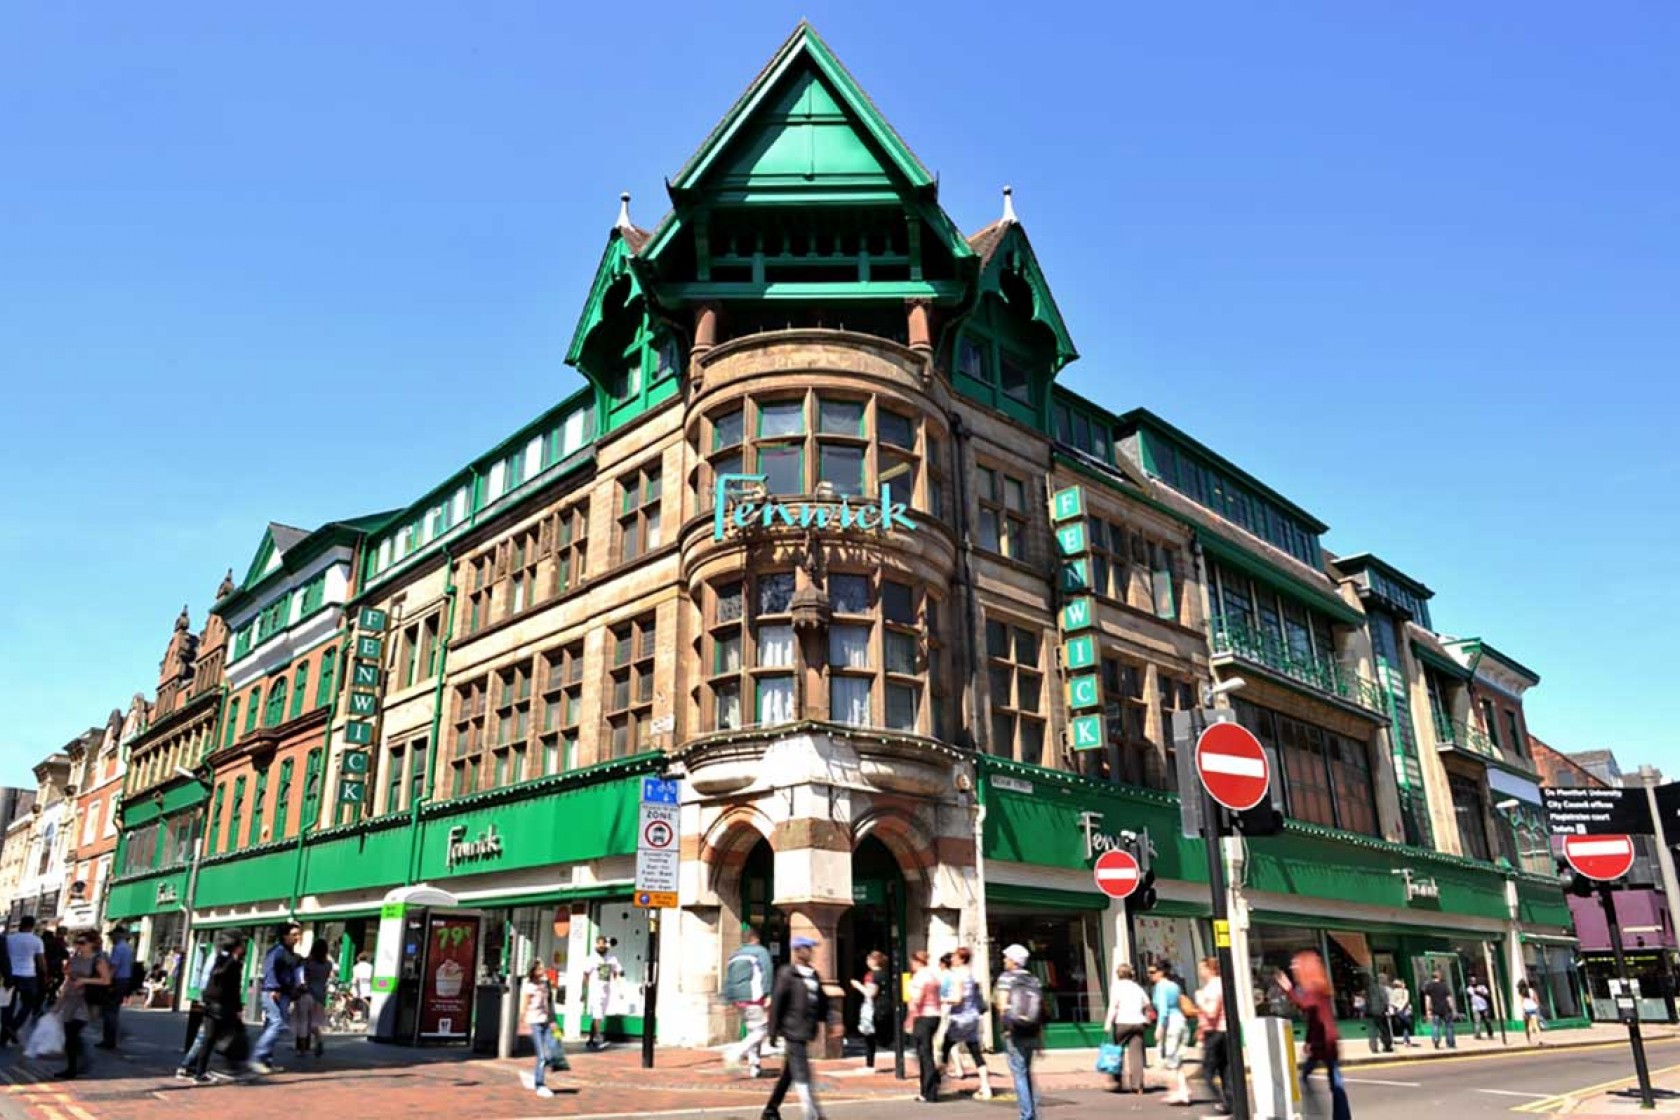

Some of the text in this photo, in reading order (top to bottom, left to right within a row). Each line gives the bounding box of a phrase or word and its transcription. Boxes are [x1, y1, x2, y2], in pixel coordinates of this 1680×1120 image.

[712, 473, 917, 542] Fenwick
[1060, 498, 1097, 744] FENWICK
[343, 611, 379, 799] FENWICK
[1077, 810, 1159, 860] Fenk
